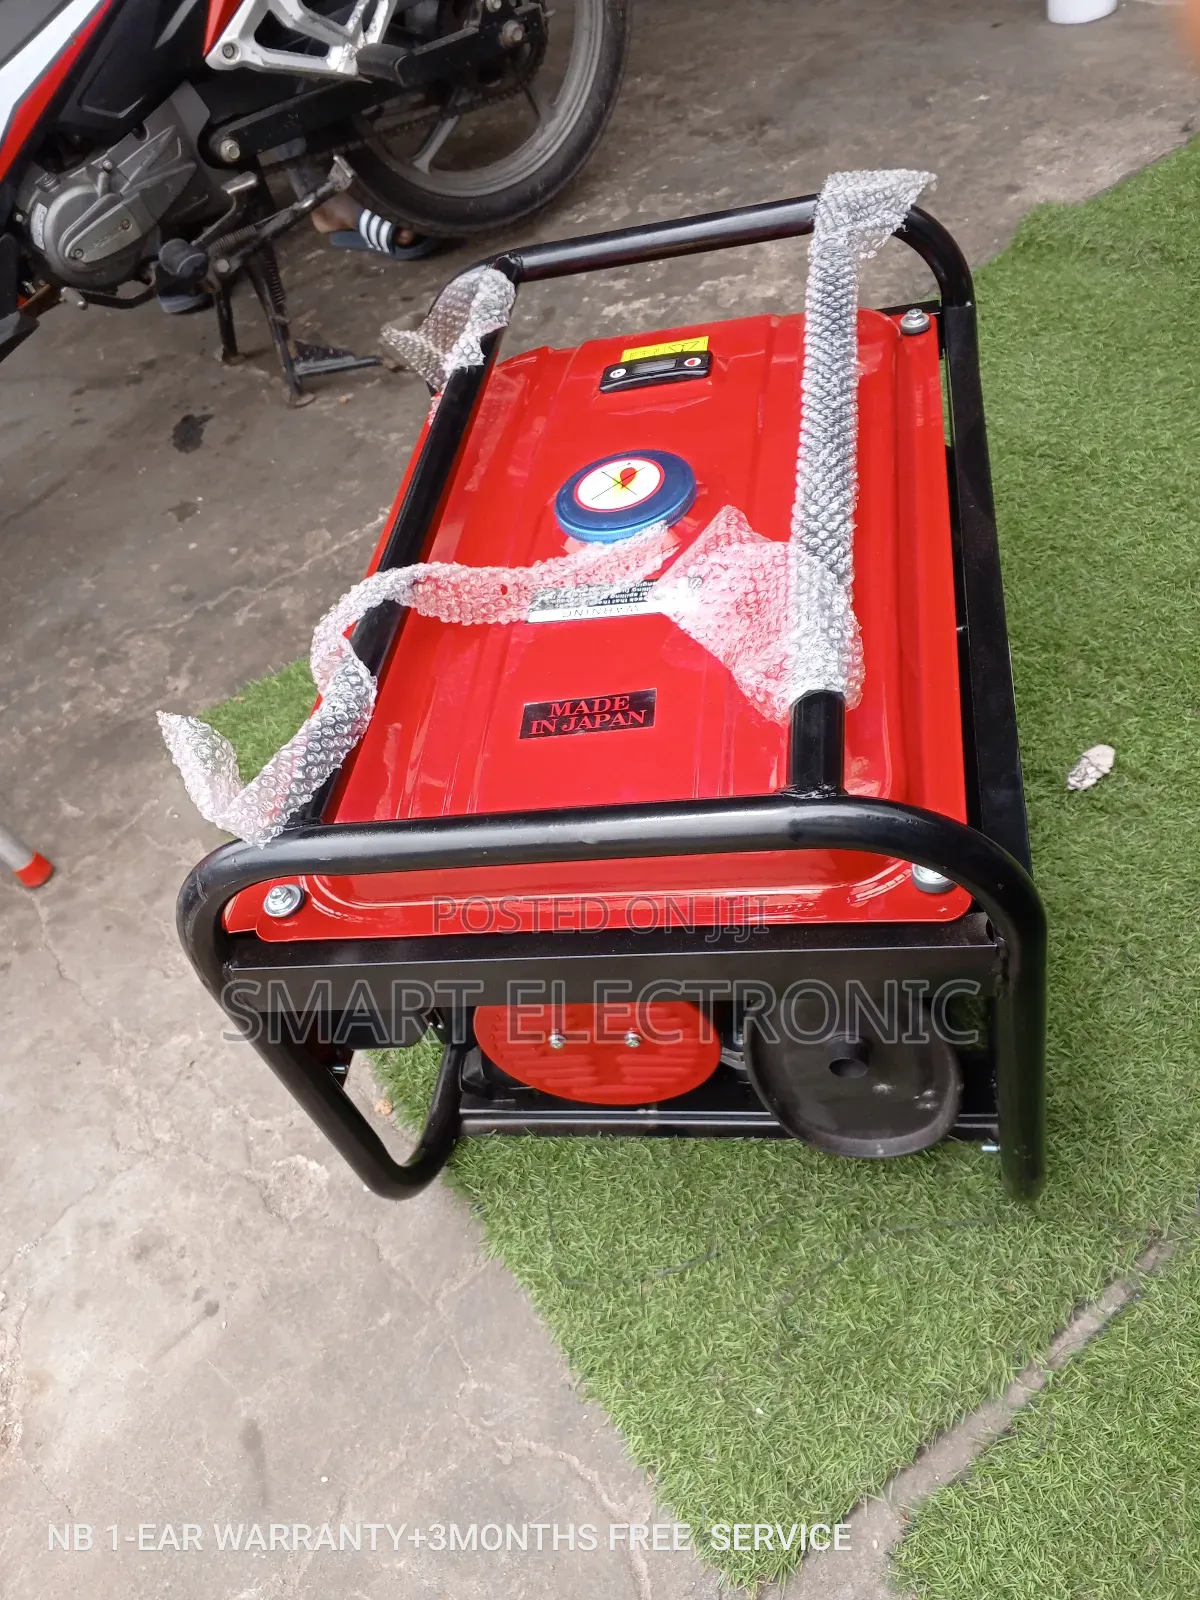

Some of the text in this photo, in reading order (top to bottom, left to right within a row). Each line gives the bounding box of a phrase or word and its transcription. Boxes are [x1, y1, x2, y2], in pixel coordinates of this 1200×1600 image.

[548, 695, 630, 718] MADE
[529, 709, 648, 735] IN JAPAN
